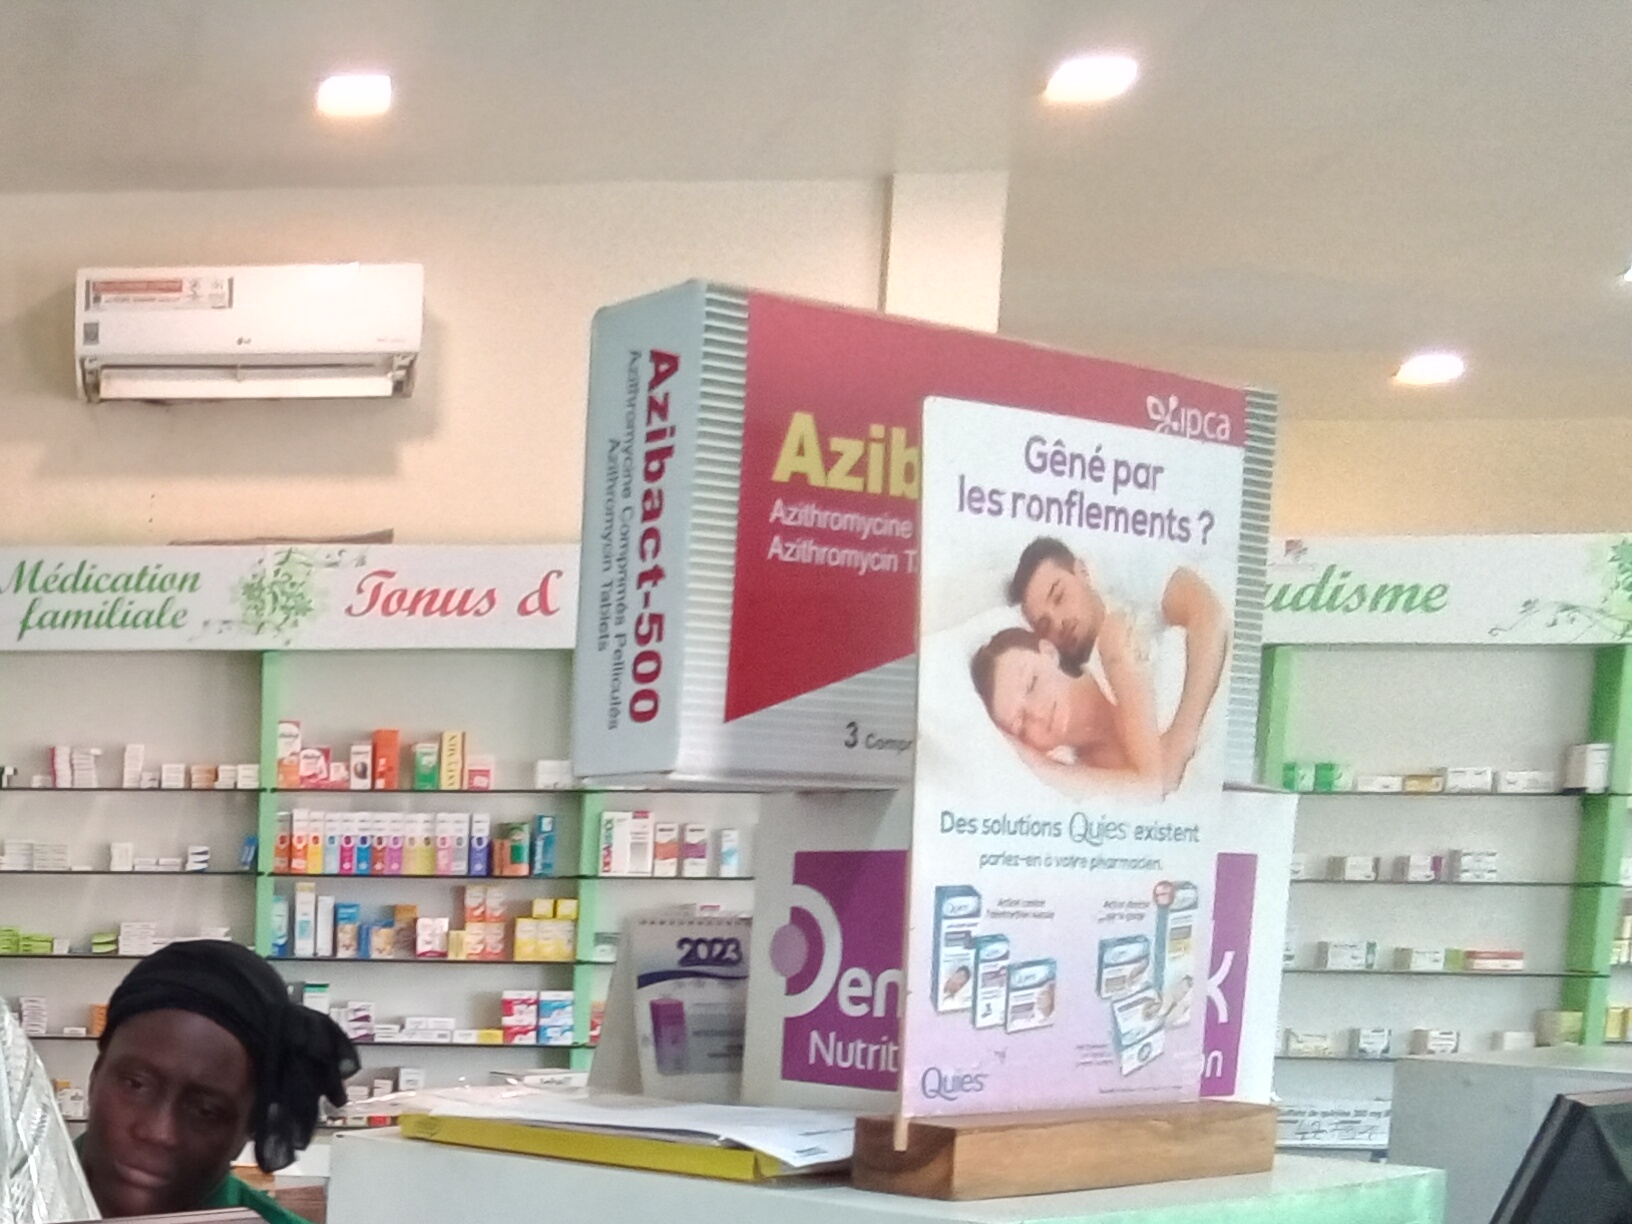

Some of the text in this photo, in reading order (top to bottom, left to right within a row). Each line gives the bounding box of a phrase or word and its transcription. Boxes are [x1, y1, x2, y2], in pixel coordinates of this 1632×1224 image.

[771, 411, 921, 500] Azib
[1024, 435, 1164, 496] Gêné par
[768, 498, 914, 541] Azithromycine
[957, 473, 1216, 546] les ronflements ?
[629, 349, 681, 724] Azibact-500
[767, 535, 899, 577] Azithromycin
[344, 568, 497, 618] Tonus
[16, 596, 188, 643] familiale
[843, 720, 859, 750] 3
[939, 810, 978, 836] Des
[981, 812, 1063, 838] solutions
[1133, 821, 1201, 844] existent
[676, 936, 744, 968] 2023
